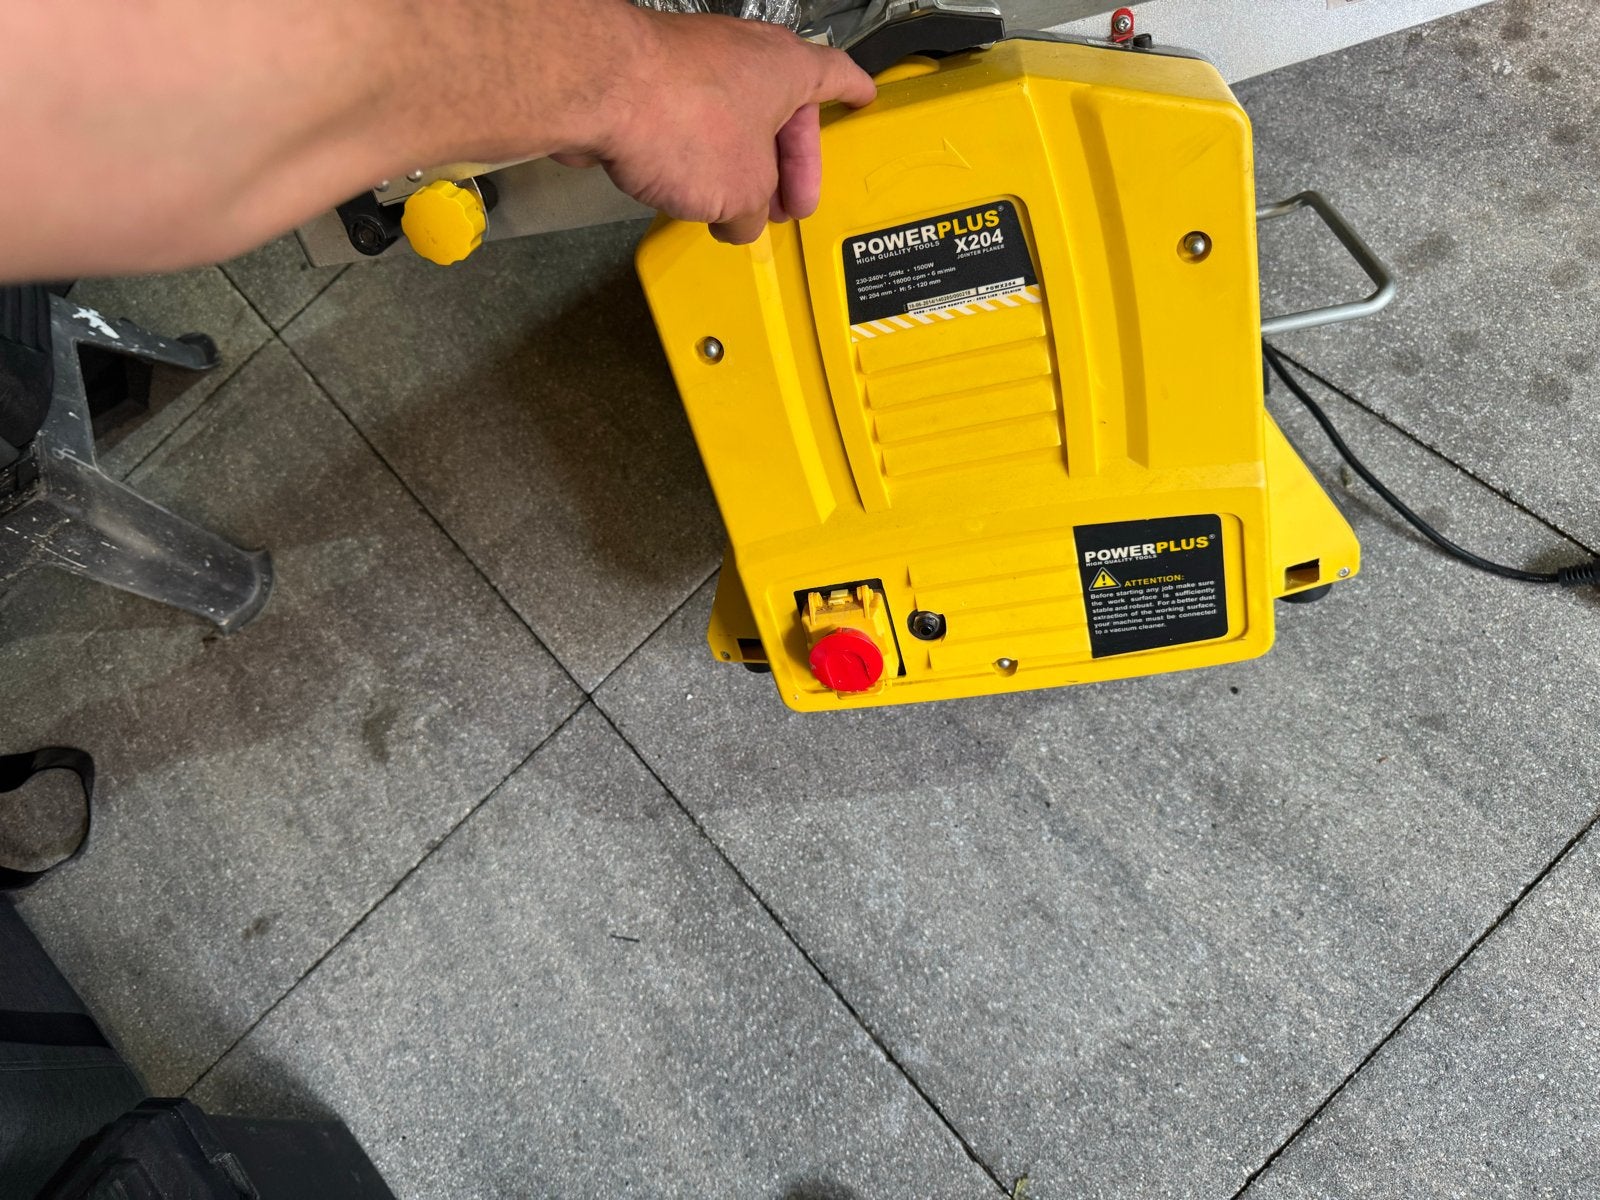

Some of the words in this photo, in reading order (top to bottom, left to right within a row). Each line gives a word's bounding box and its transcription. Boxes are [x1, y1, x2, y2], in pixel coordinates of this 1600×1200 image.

[954, 229, 1003, 253] X204
[856, 256, 876, 264] HIGH
[879, 247, 913, 260] QUALITY
[914, 241, 940, 251] TOOLS
[957, 250, 981, 259] JOINTER
[982, 244, 1005, 253] PLANER
[913, 263, 934, 271] 1500W
[1125, 574, 1185, 587] ATTENTION:
[1175, 588, 1215, 597] sufficiently
[1179, 609, 1216, 618] connected
